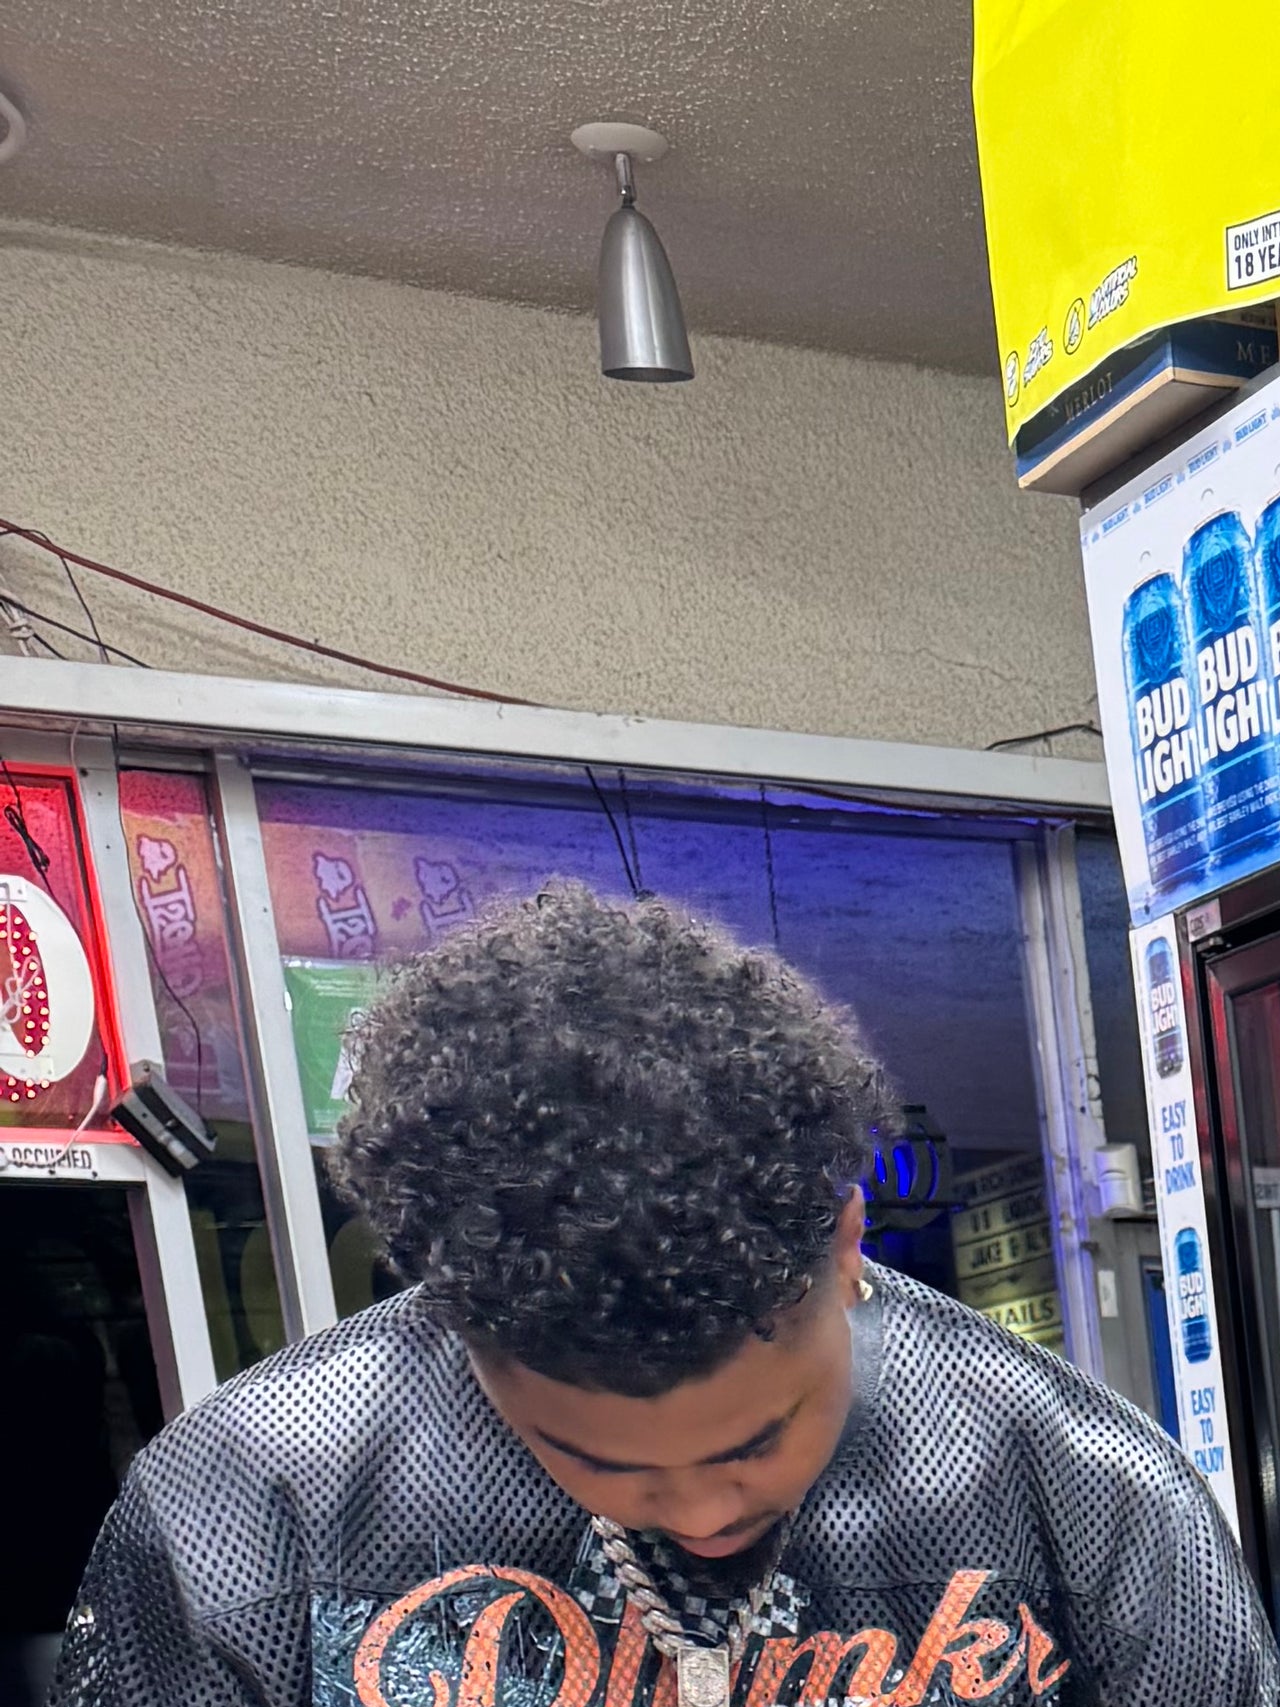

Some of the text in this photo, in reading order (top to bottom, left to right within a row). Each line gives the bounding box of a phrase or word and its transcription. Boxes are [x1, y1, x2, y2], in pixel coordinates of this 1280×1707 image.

[1233, 225, 1260, 251] ONLY
[1234, 251, 1255, 279] 18
[1197, 624, 1259, 700] BUD
[1136, 674, 1192, 750] BUD
[1199, 678, 1272, 764] LIGHT
[1150, 983, 1176, 1010] BUD
[1162, 1100, 1187, 1132] EASY
[1170, 1136, 1185, 1161] TO
[1165, 1157, 1196, 1196] DRINK
[1179, 1273, 1204, 1297] BUD
[1191, 1386, 1216, 1416] EASY
[1200, 1418, 1215, 1444] TO
